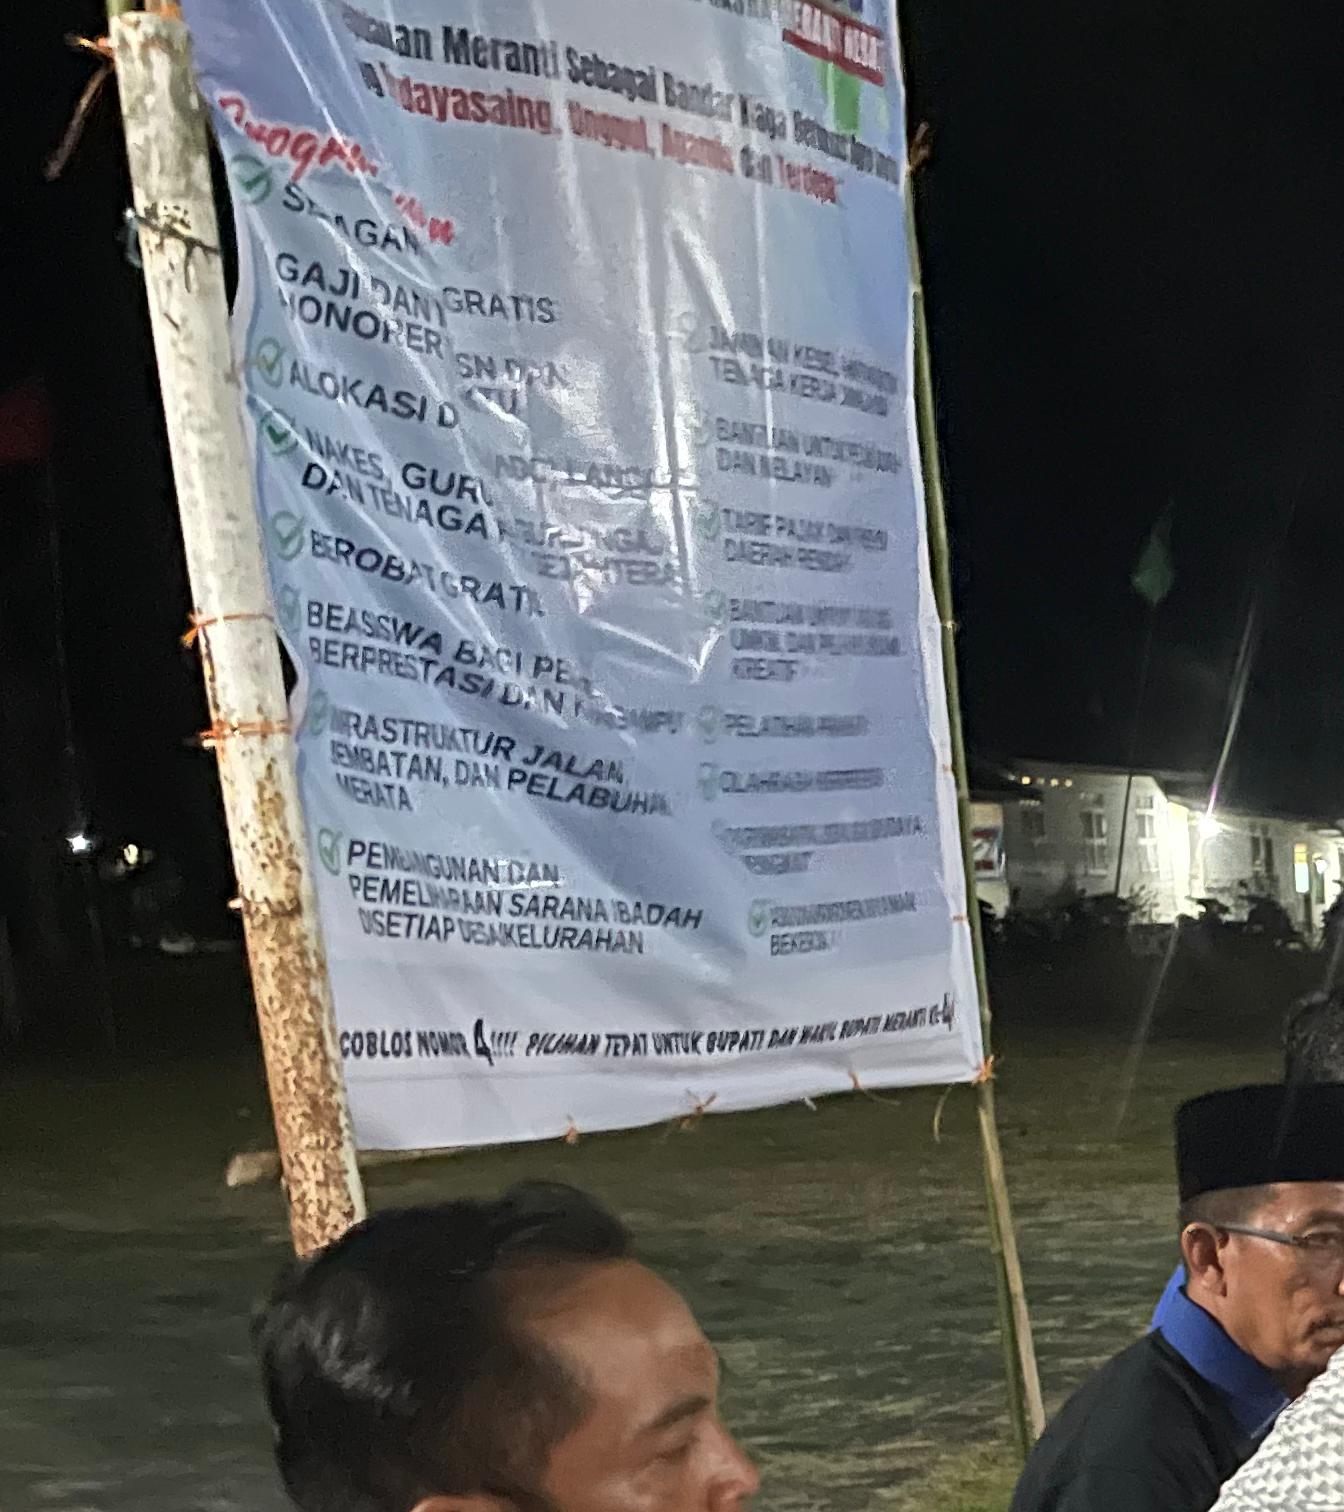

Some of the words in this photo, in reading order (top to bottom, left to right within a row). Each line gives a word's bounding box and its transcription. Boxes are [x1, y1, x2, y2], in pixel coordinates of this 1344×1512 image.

[442, 24, 559, 79] Meranti
[274, 252, 360, 300] GAJI
[441, 286, 556, 325] GRATIS
[289, 360, 426, 422] ALOKASI
[508, 892, 607, 922] SARANA
[339, 1030, 413, 1060] COBLOS
[651, 1029, 705, 1056] UNTUK
[705, 1029, 765, 1055] BUPATI
